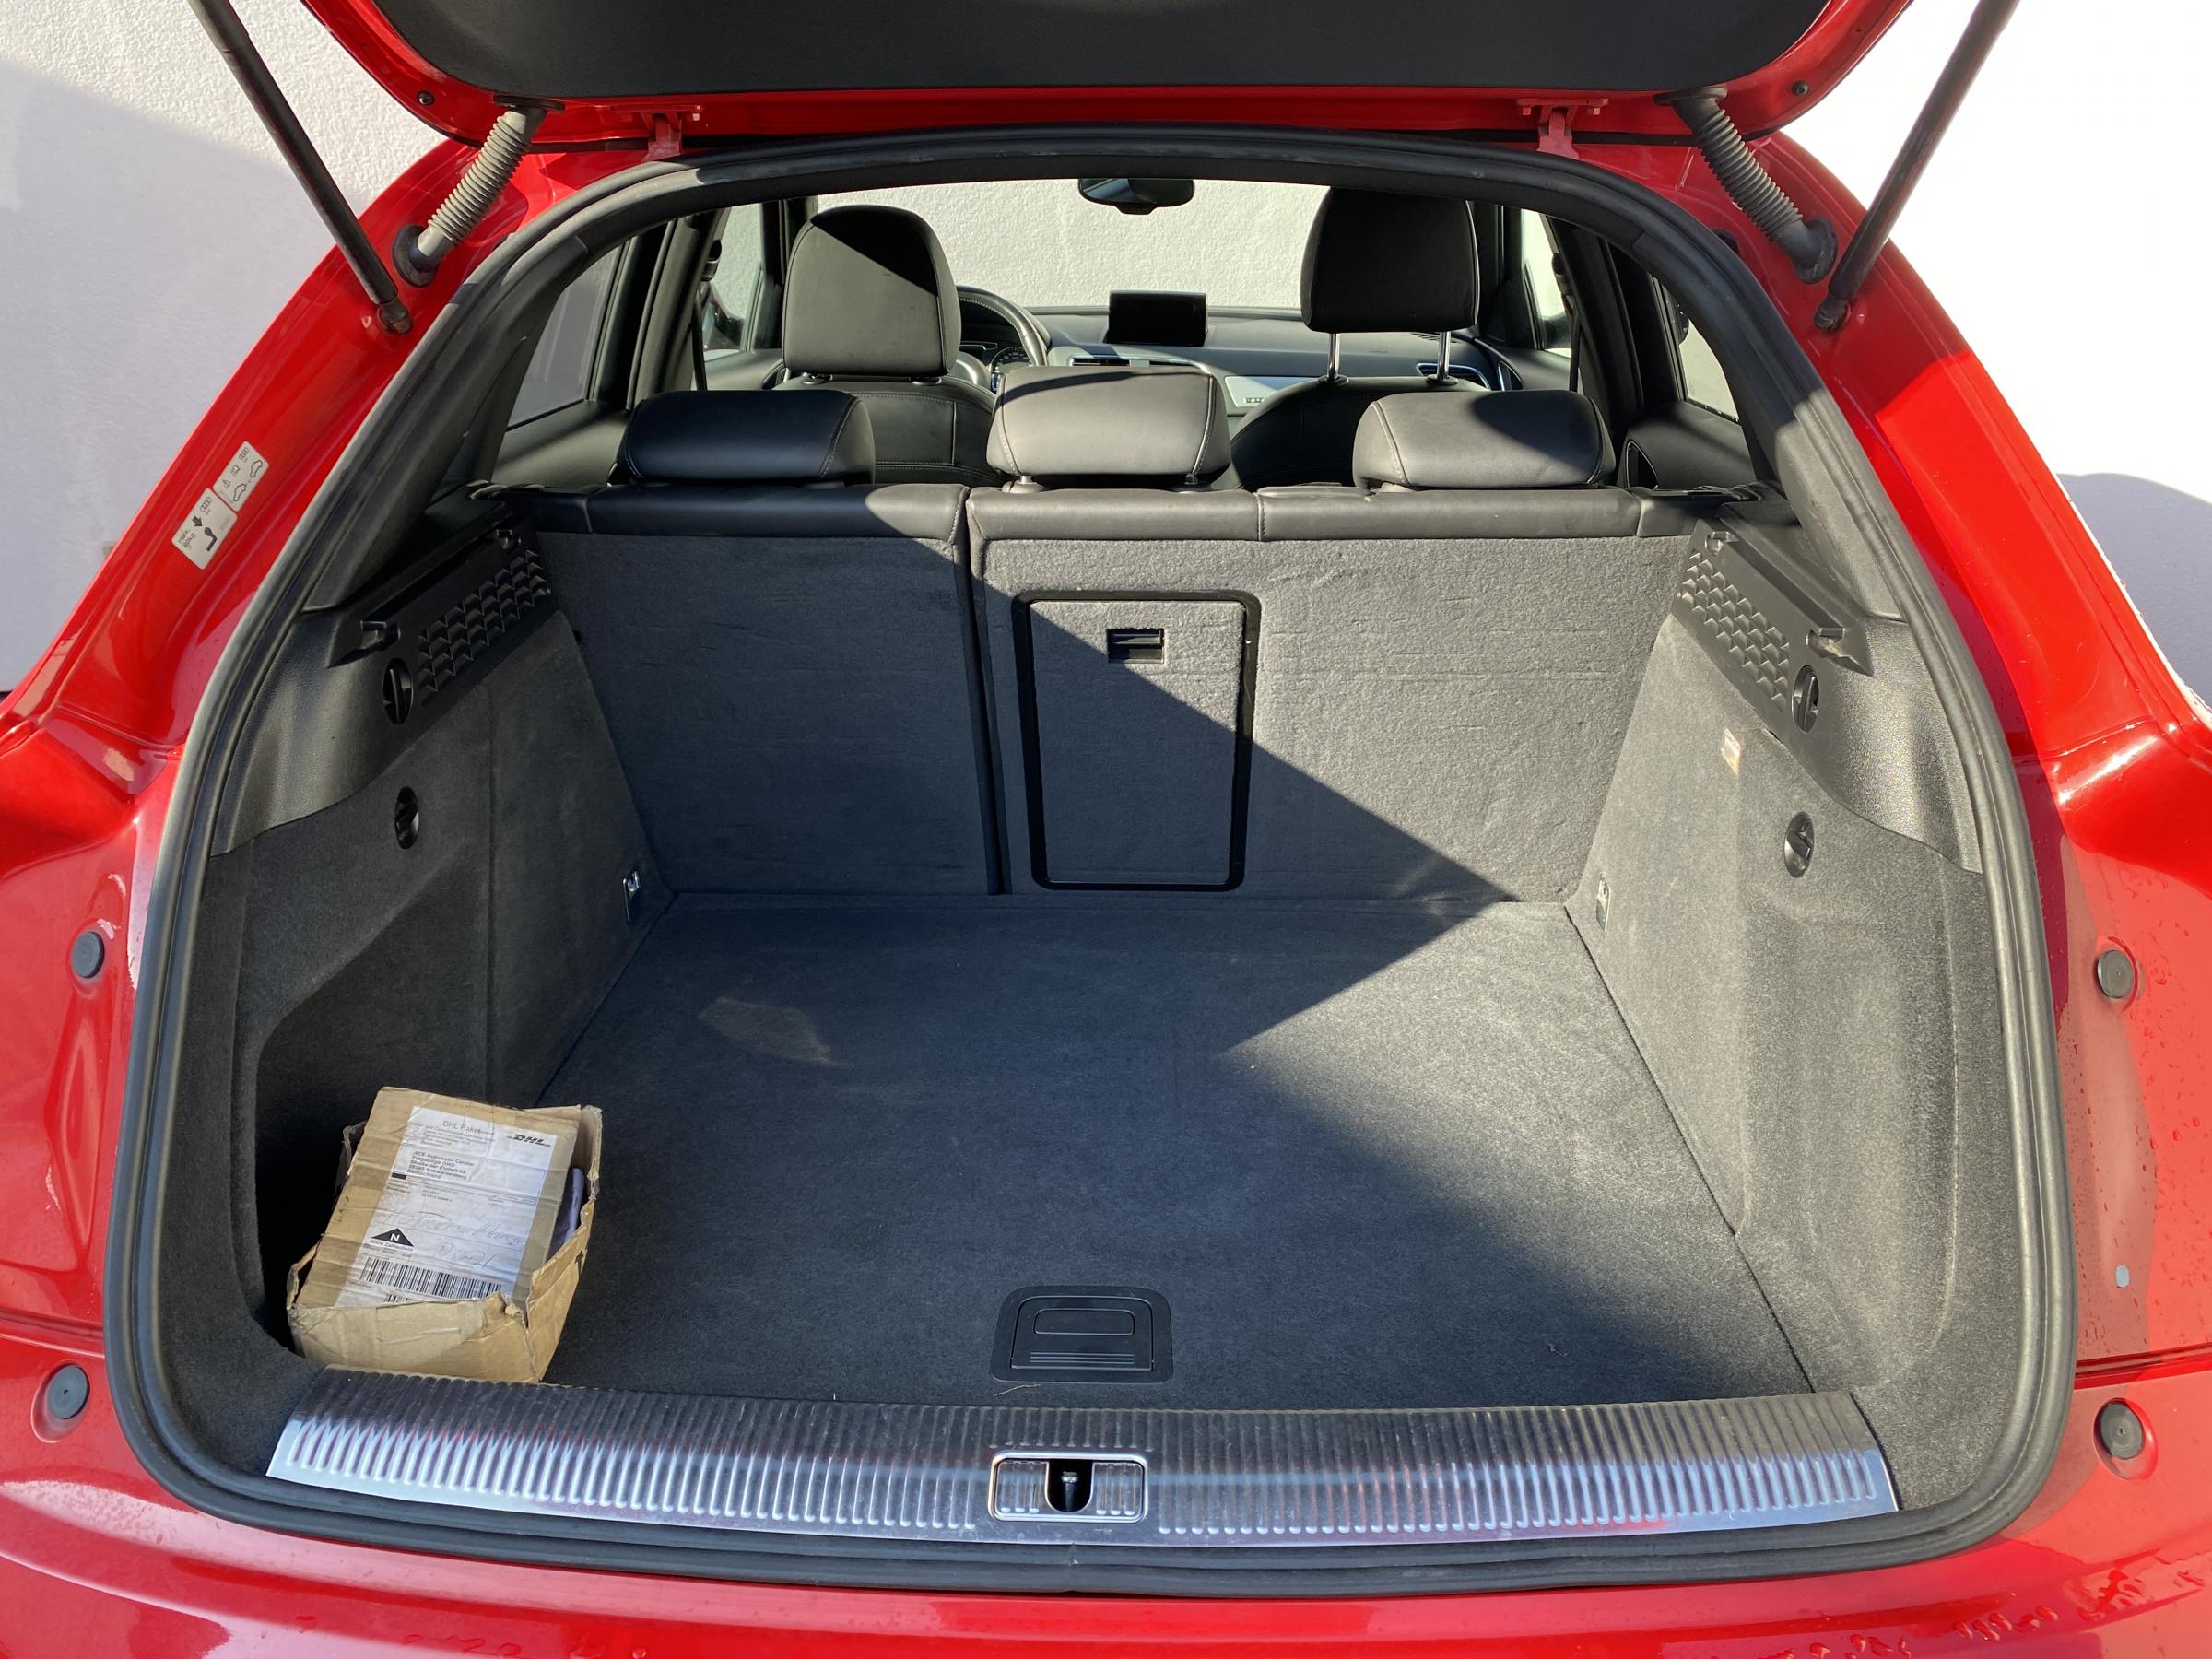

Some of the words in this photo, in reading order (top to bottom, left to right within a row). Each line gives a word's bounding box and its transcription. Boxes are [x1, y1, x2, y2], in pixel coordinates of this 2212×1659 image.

[442, 1120, 459, 1130] DHL
[512, 1134, 547, 1146] DHL
[390, 1233, 400, 1241] N
